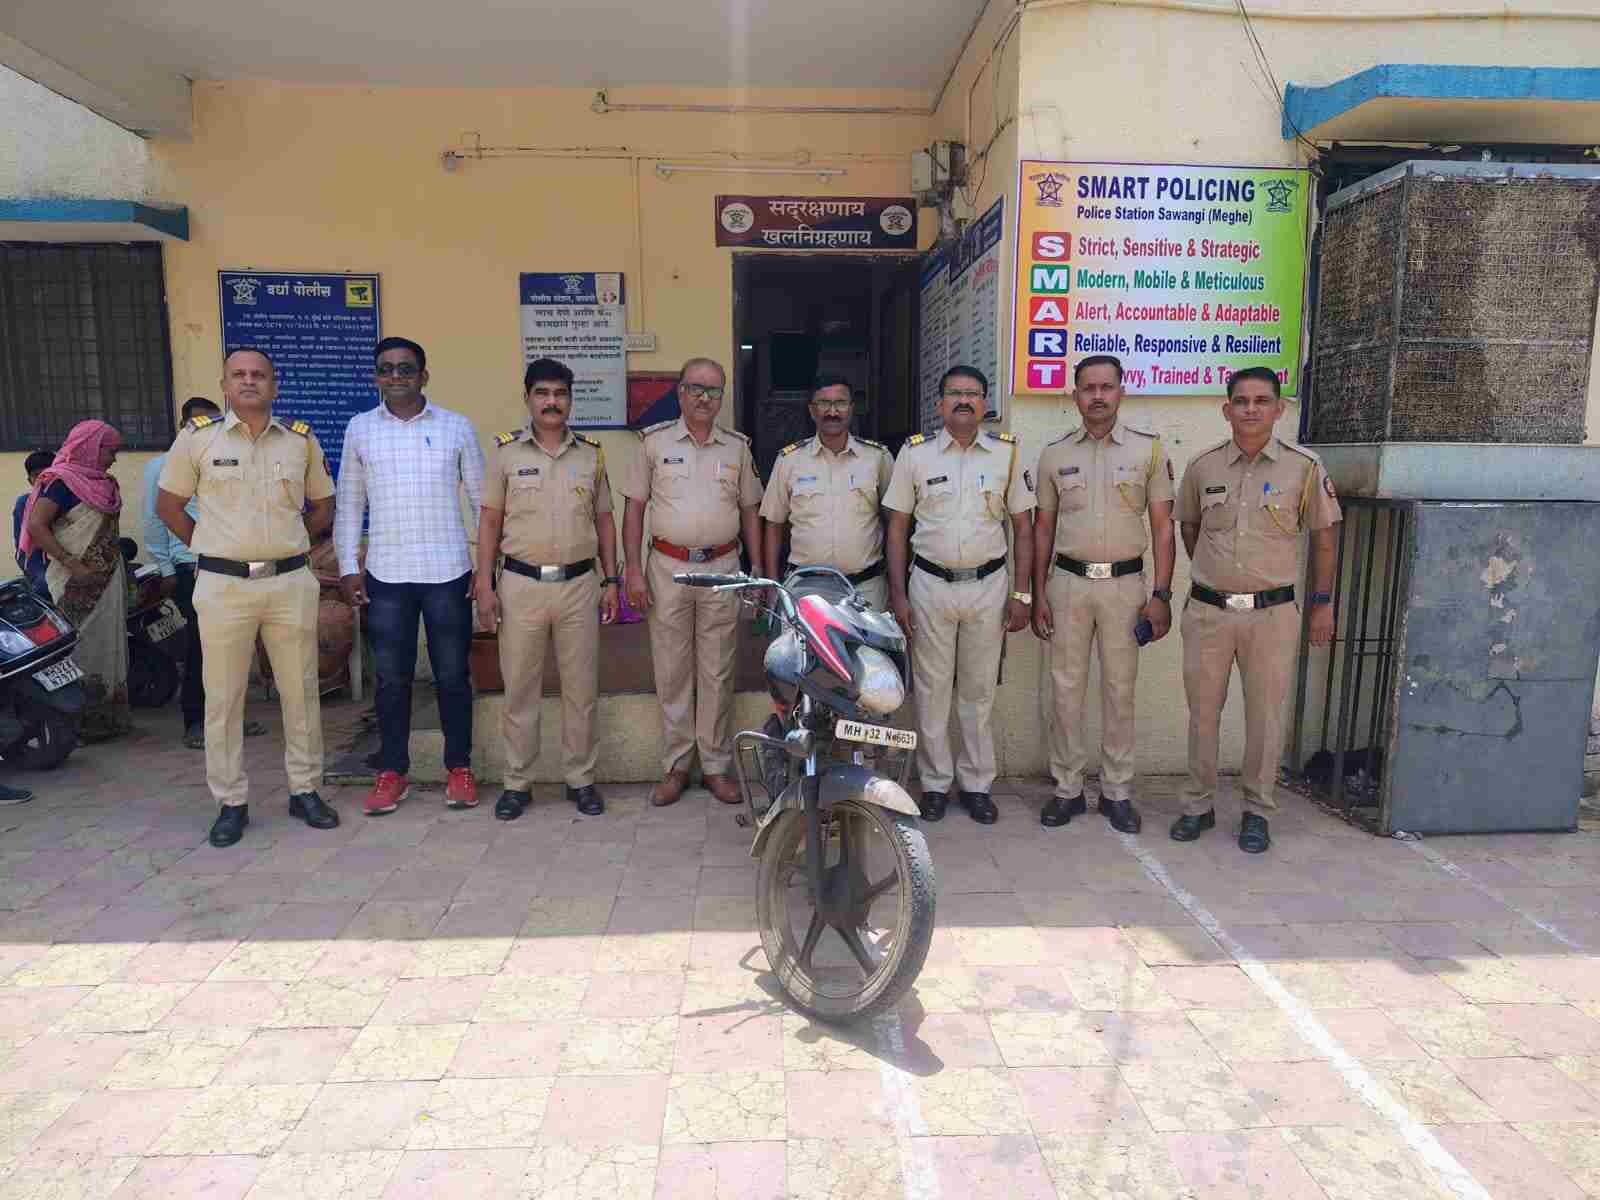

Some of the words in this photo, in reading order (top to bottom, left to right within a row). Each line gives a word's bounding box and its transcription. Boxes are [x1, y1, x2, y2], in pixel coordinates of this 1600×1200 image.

[1077, 176, 1150, 199] SMART
[1156, 177, 1255, 202] POLICING
[1077, 205, 1111, 220] Police
[1115, 206, 1155, 221] Station
[1158, 207, 1205, 224] Sawangi
[1208, 208, 1253, 225] (Meghe)
[761, 223, 872, 247] खलनिग्रहणाय
[1037, 236, 1066, 254] S
[1079, 236, 1119, 260] Strict,
[1123, 237, 1182, 257] Sensitive
[1187, 238, 1196, 257] &
[1201, 238, 1260, 262] Strategic
[294, 281, 332, 297] पोलीस
[1032, 269, 1067, 290] M
[1077, 270, 1129, 292] Modern,
[1134, 271, 1176, 290] Mobile
[1181, 271, 1190, 289] &
[1195, 271, 1265, 291] Meticulous
[1033, 301, 1065, 321] A
[1075, 302, 1111, 322] Alert,
[1116, 303, 1197, 322] Accountable
[1202, 303, 1210, 321] &
[1215, 303, 1280, 325] Adaptable
[1035, 332, 1063, 352] R
[1074, 333, 1130, 356] Reliable,
[1135, 334, 1207, 355] Responsive
[1211, 335, 1221, 353] &
[1226, 335, 1281, 353] Resilient
[1033, 364, 1061, 384] T
[1151, 364, 1199, 384] Trained
[1203, 366, 1212, 384] &
[844, 724, 862, 737] MH
[869, 727, 881, 740] 32
